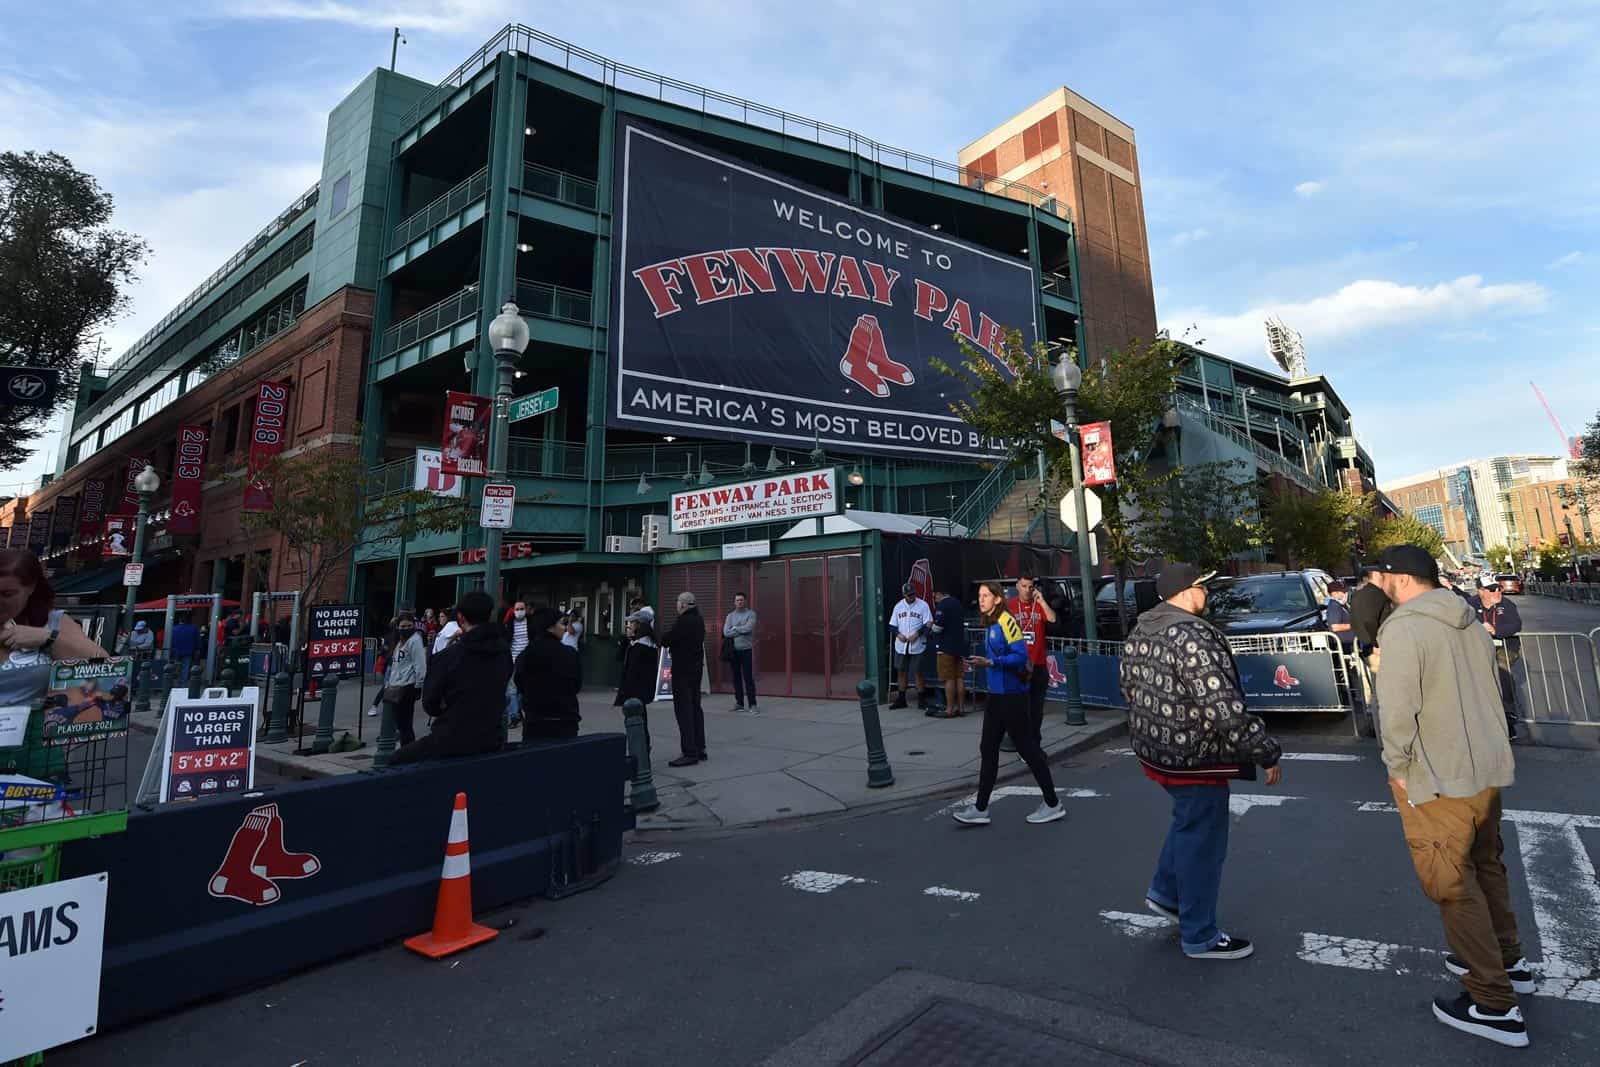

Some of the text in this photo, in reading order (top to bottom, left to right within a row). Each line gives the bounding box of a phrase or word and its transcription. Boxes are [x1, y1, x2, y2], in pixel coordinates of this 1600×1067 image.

[772, 199, 952, 270] WELCOME TO
[632, 247, 900, 319] FENWAY
[255, 384, 286, 444] 2018
[516, 394, 544, 418] JERSEY
[630, 387, 785, 426] AMERICA'S
[796, 412, 859, 435] MOST
[868, 421, 962, 446] BELOVED
[178, 429, 205, 479] 2013
[675, 473, 830, 512] FENWAY PARK
[673, 512, 690, 521] GATE
[700, 507, 724, 517] STAIRS
[731, 502, 770, 513] ENTRANCE
[773, 498, 788, 507] ALL
[791, 492, 833, 504] SECTIONS
[679, 503, 824, 529] JERSEY STREET VAN NESS STREET
[315, 609, 359, 619] NO BAGS
[317, 619, 357, 628] LARGER
[324, 628, 350, 637] THAN
[73, 663, 114, 675] YAWKEY
[184, 710, 245, 722] NO BAGS
[57, 720, 113, 734] PLAYOFFS 2021
[185, 722, 241, 734] LARGER
[194, 735, 231, 746] THAN
[5, 785, 56, 798] BOSTON
